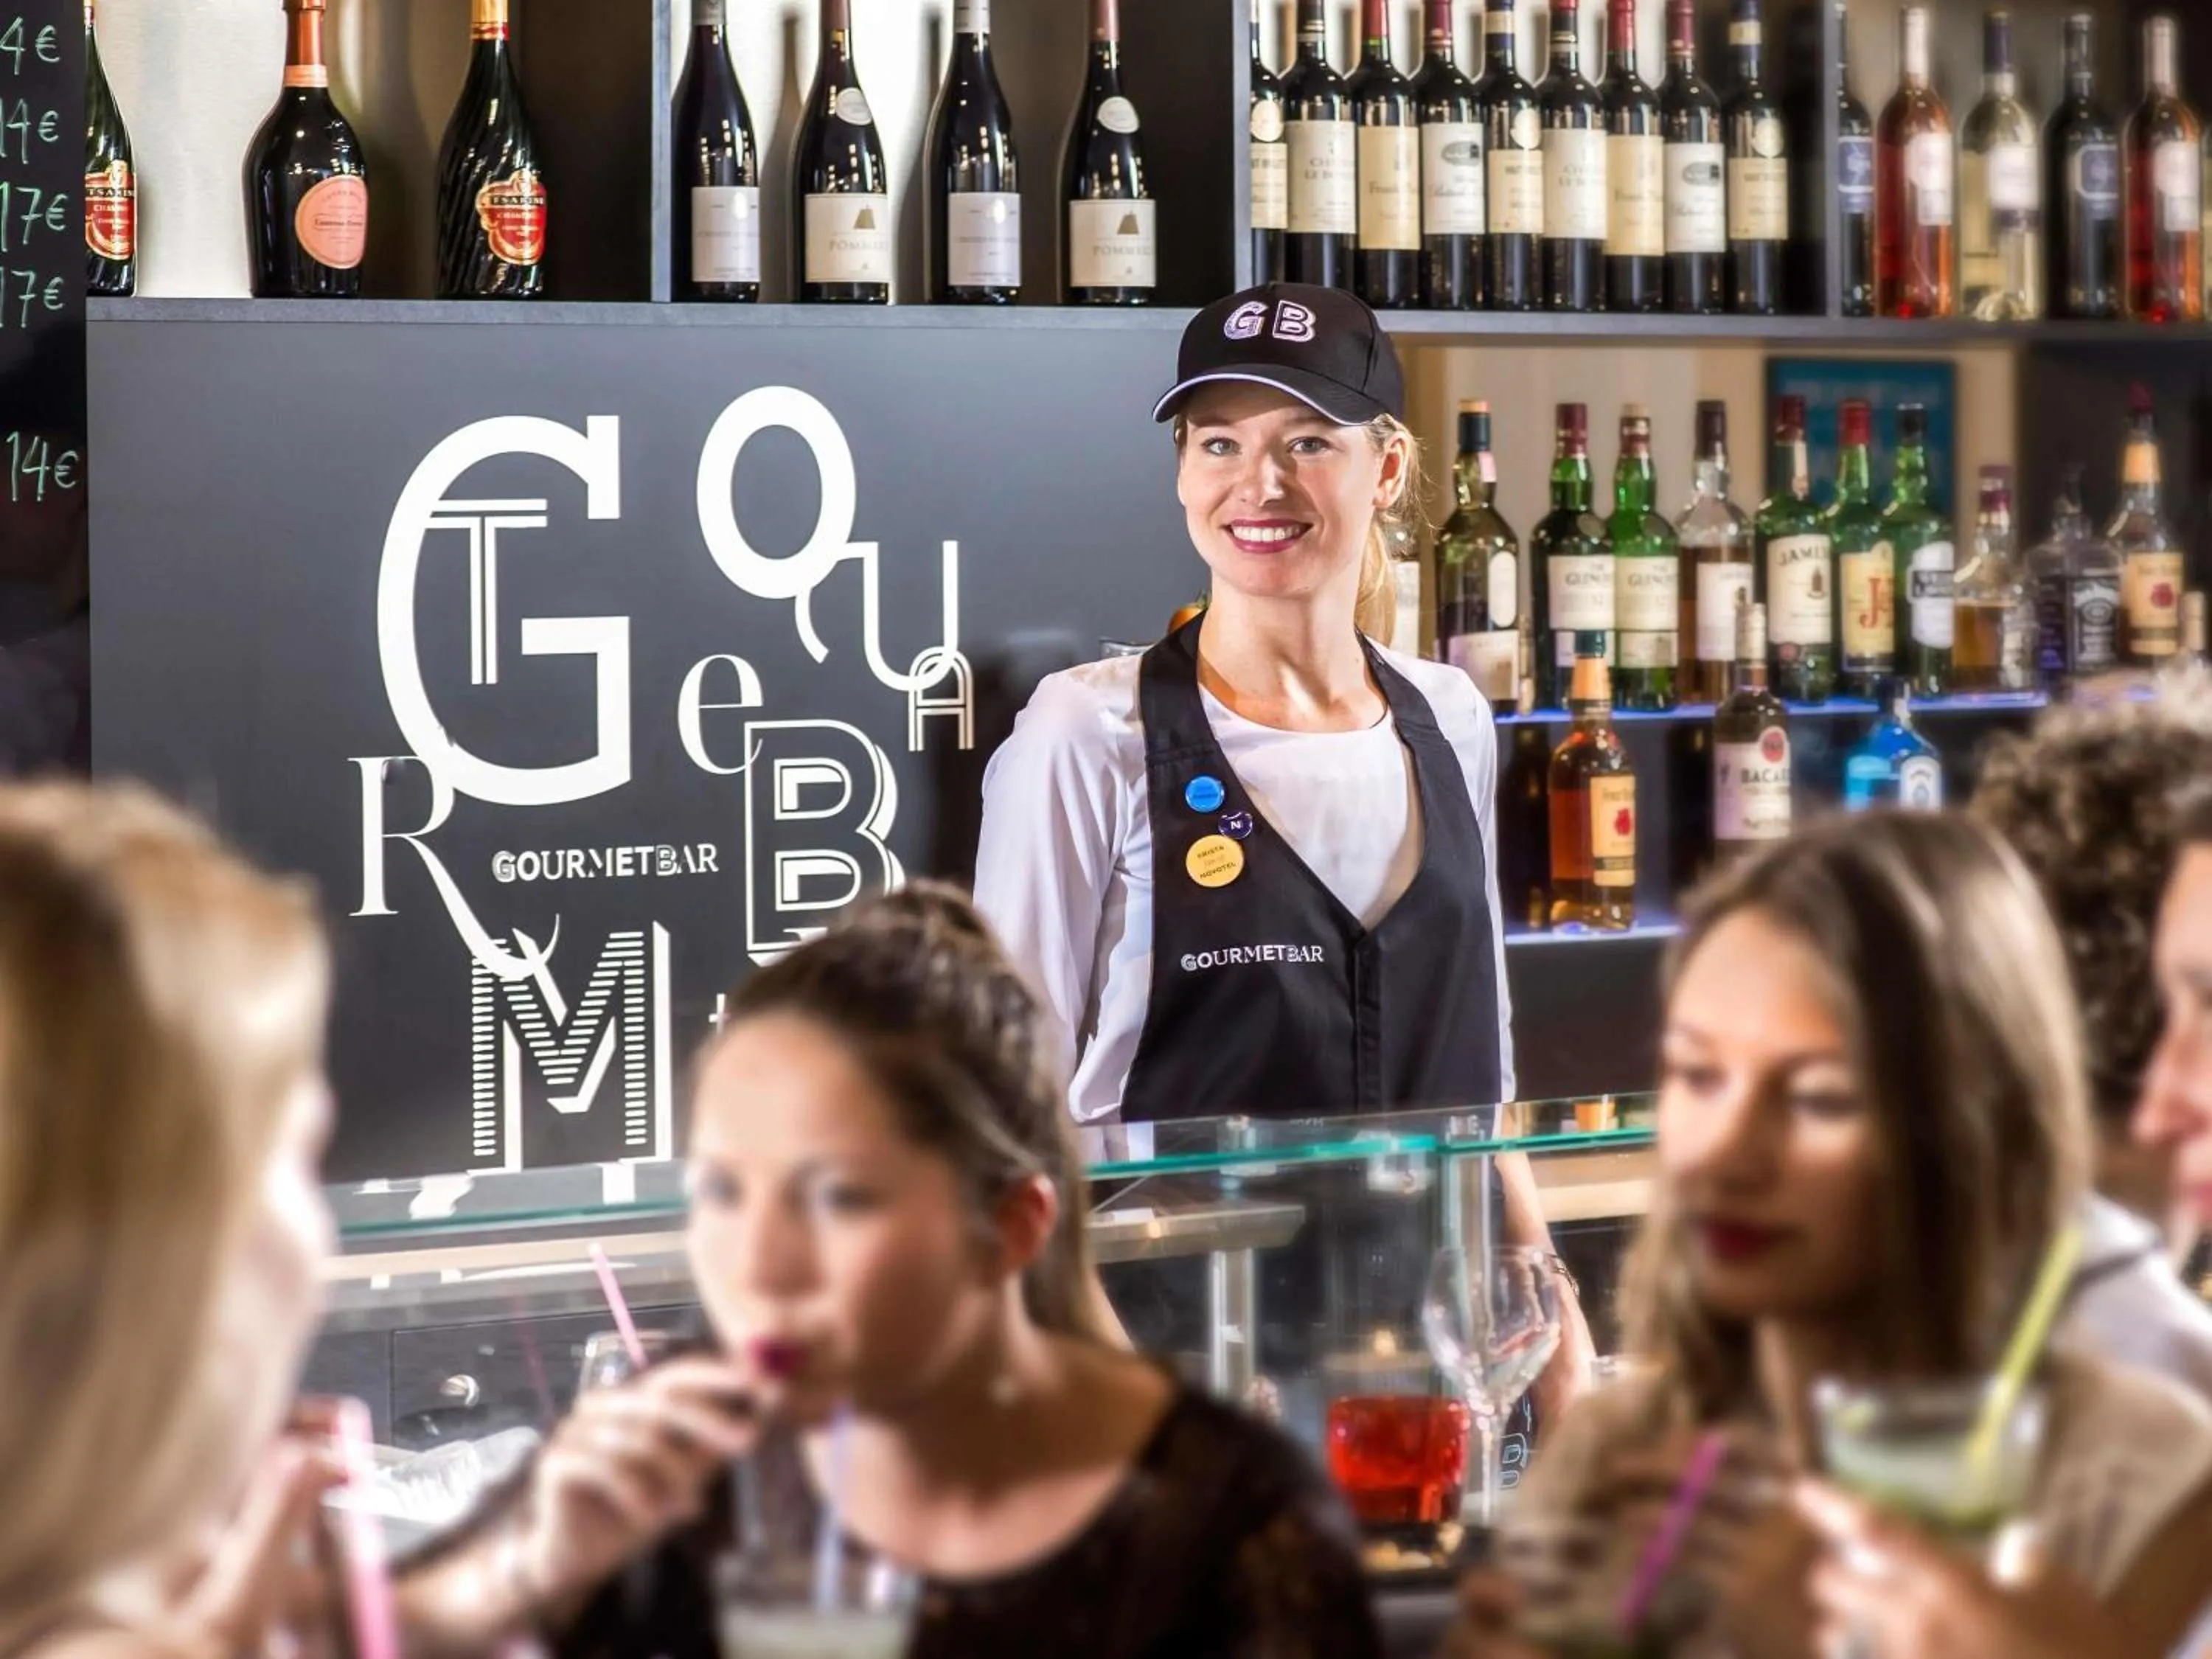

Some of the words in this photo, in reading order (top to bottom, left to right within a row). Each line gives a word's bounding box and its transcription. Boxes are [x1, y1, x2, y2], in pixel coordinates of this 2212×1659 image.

[0, 181, 68, 252] 17€
[6, 431, 79, 502] 14€
[377, 415, 632, 805] G
[1230, 821, 1242, 830] N
[492, 843, 720, 883] GOURMETBAR
[1200, 861, 1237, 880] NOVOTEL
[1180, 945, 1325, 972] GOURMETBAR
